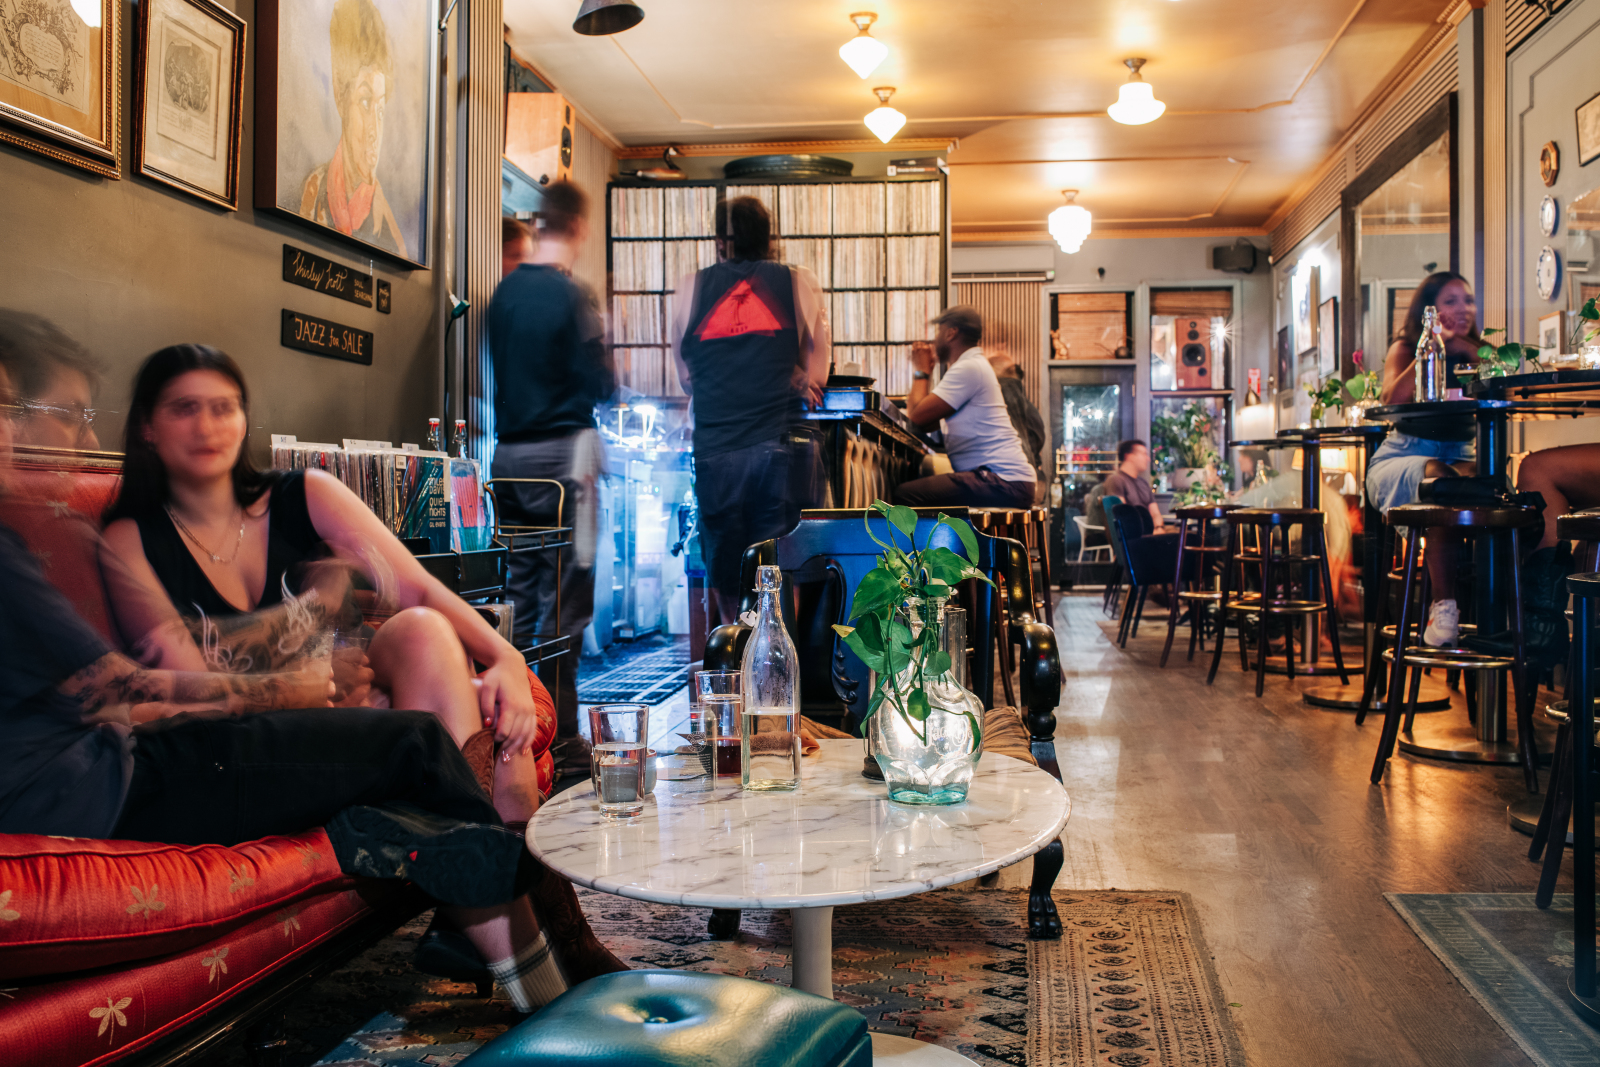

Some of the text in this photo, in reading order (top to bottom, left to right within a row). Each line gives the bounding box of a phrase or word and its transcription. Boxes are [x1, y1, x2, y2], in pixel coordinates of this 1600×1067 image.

[292, 251, 348, 292] Shirley Scott
[295, 317, 325, 346] JAZZ
[341, 330, 364, 356] SALE
